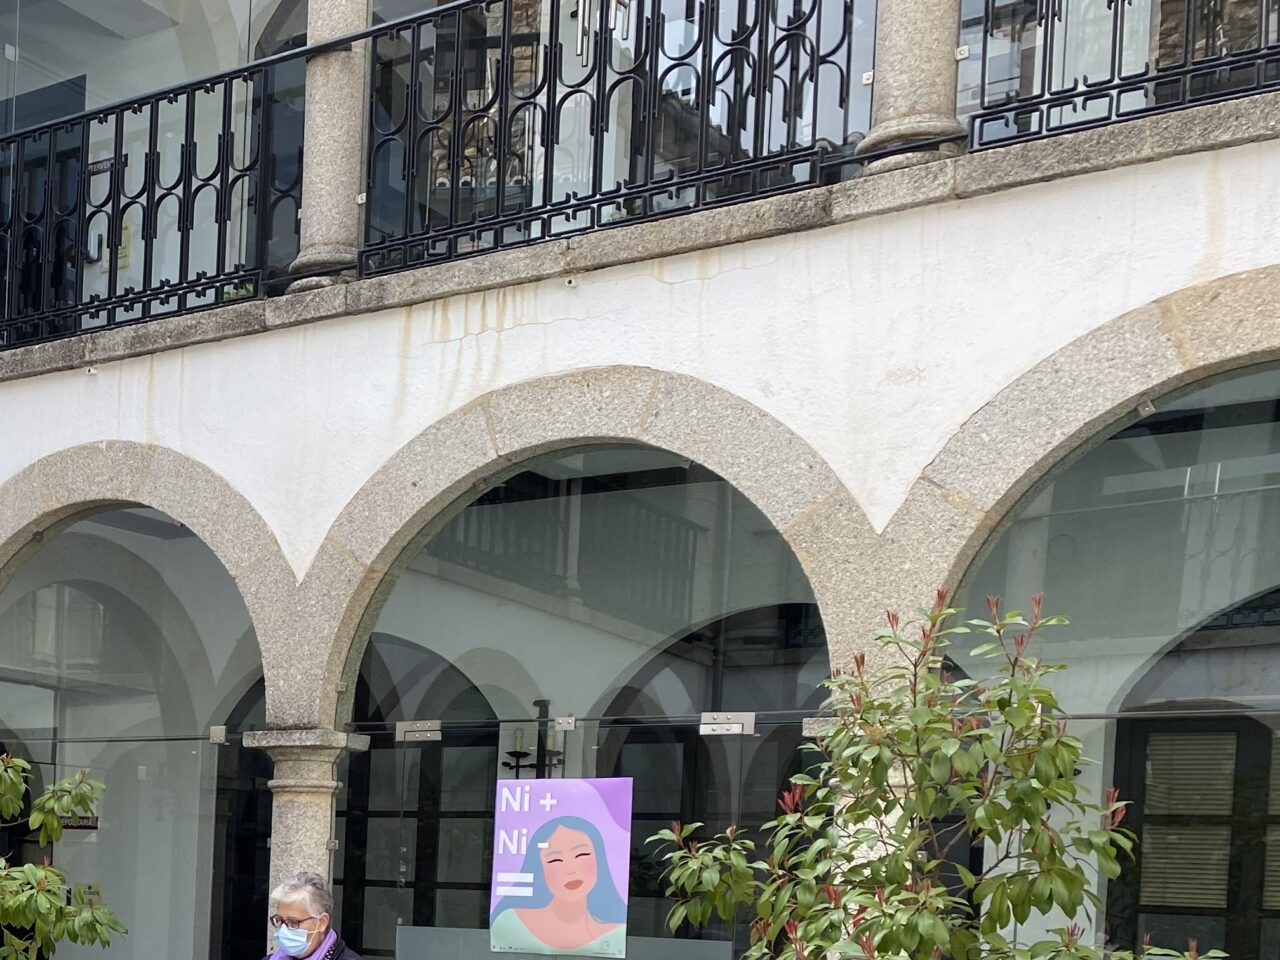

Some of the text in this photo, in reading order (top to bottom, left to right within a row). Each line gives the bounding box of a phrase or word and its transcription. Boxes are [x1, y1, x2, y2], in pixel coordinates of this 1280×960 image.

[500, 785, 558, 812] Ni +
[498, 828, 528, 855] Ni
